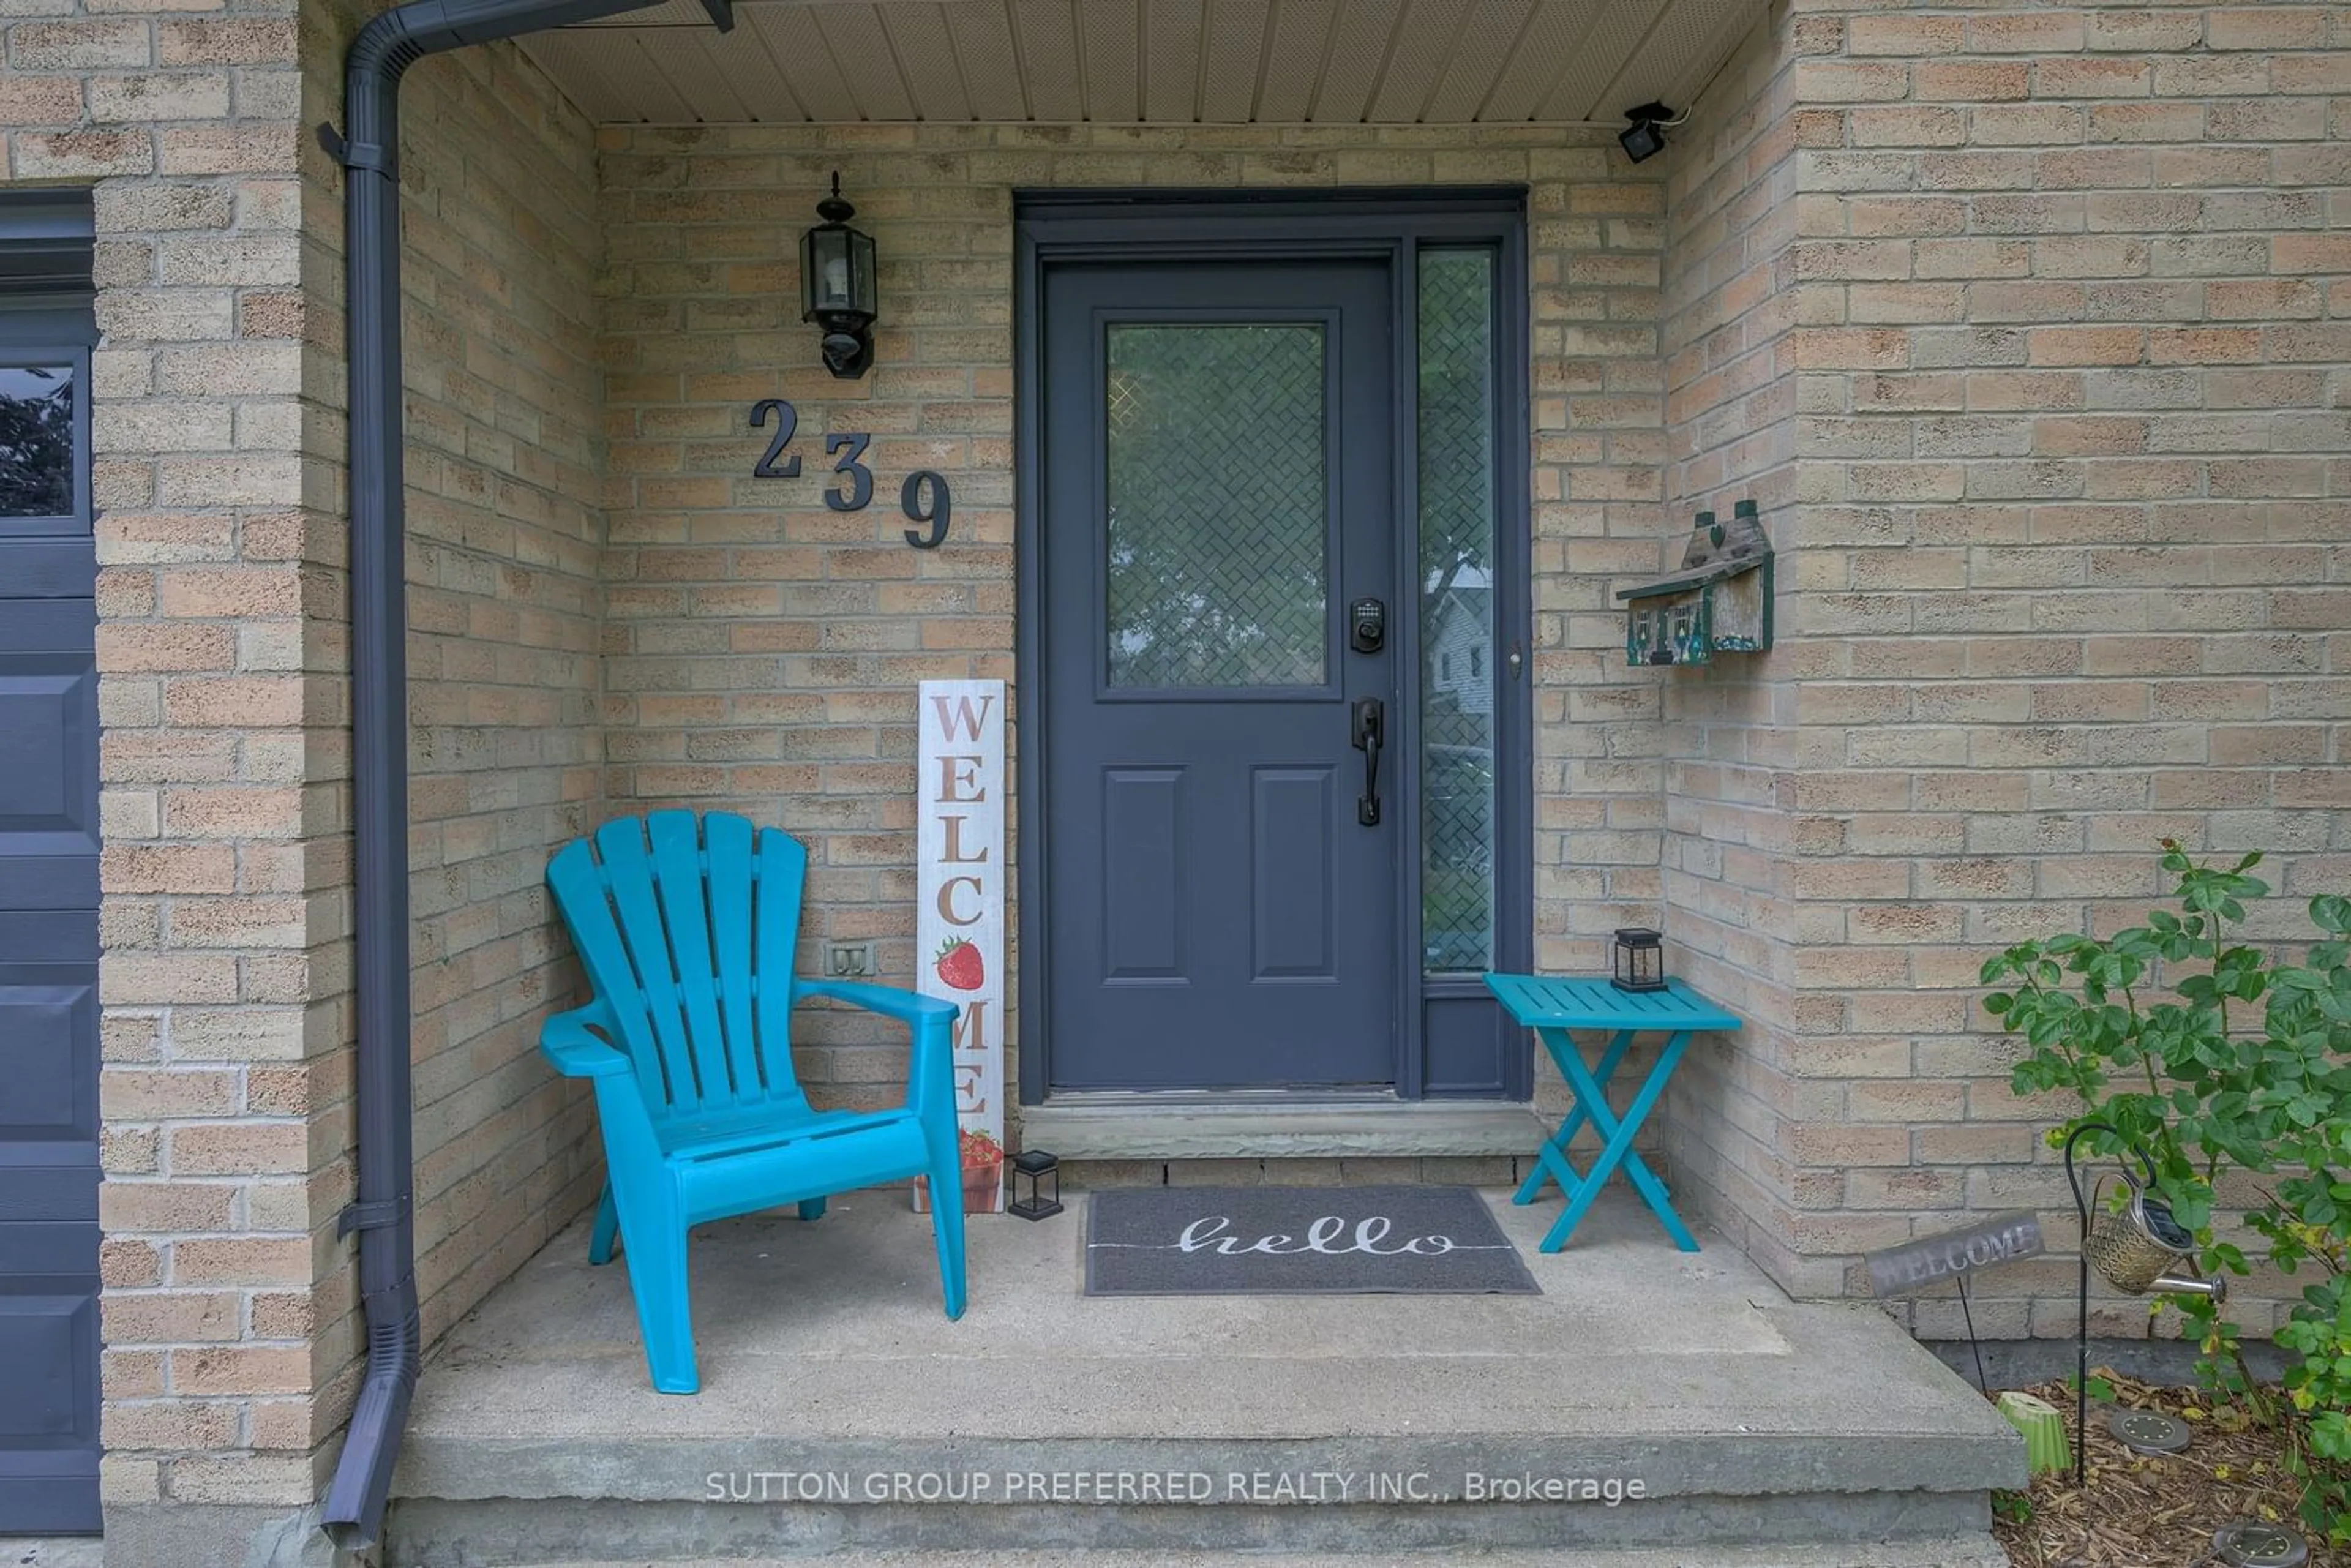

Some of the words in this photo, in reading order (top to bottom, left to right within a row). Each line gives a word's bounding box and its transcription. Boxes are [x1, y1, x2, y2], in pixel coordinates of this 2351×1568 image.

[749, 399, 951, 549] 239
[1179, 1215, 1455, 1255] hello
[1871, 1223, 2039, 1289] WELCOME
